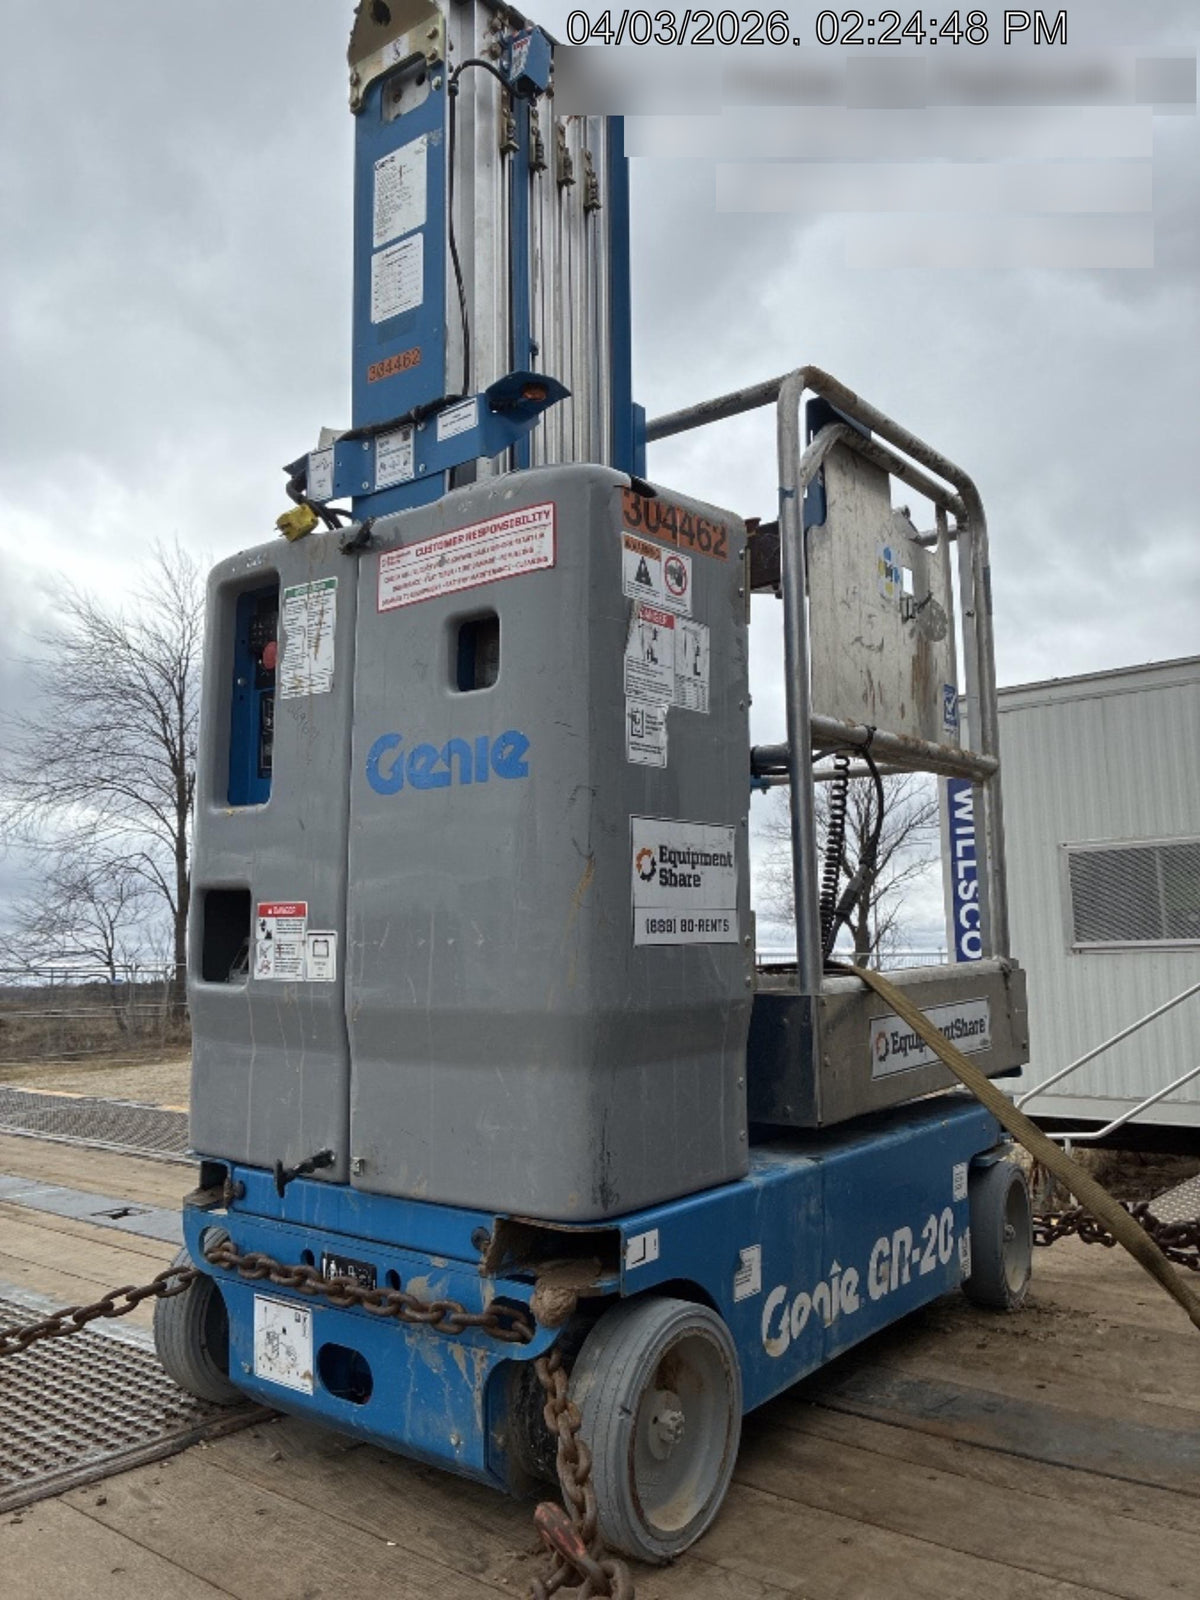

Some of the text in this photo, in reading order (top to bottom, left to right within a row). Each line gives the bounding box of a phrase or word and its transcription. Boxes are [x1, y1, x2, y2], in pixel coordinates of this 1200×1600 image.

[416, 510, 550, 557] CUSTOMER RESPONSIBILITY
[622, 487, 729, 557] 304462
[366, 729, 530, 795] Genie
[658, 844, 733, 870] Equipment
[658, 868, 702, 888] Share
[890, 1017, 986, 1058] EquipntShare
